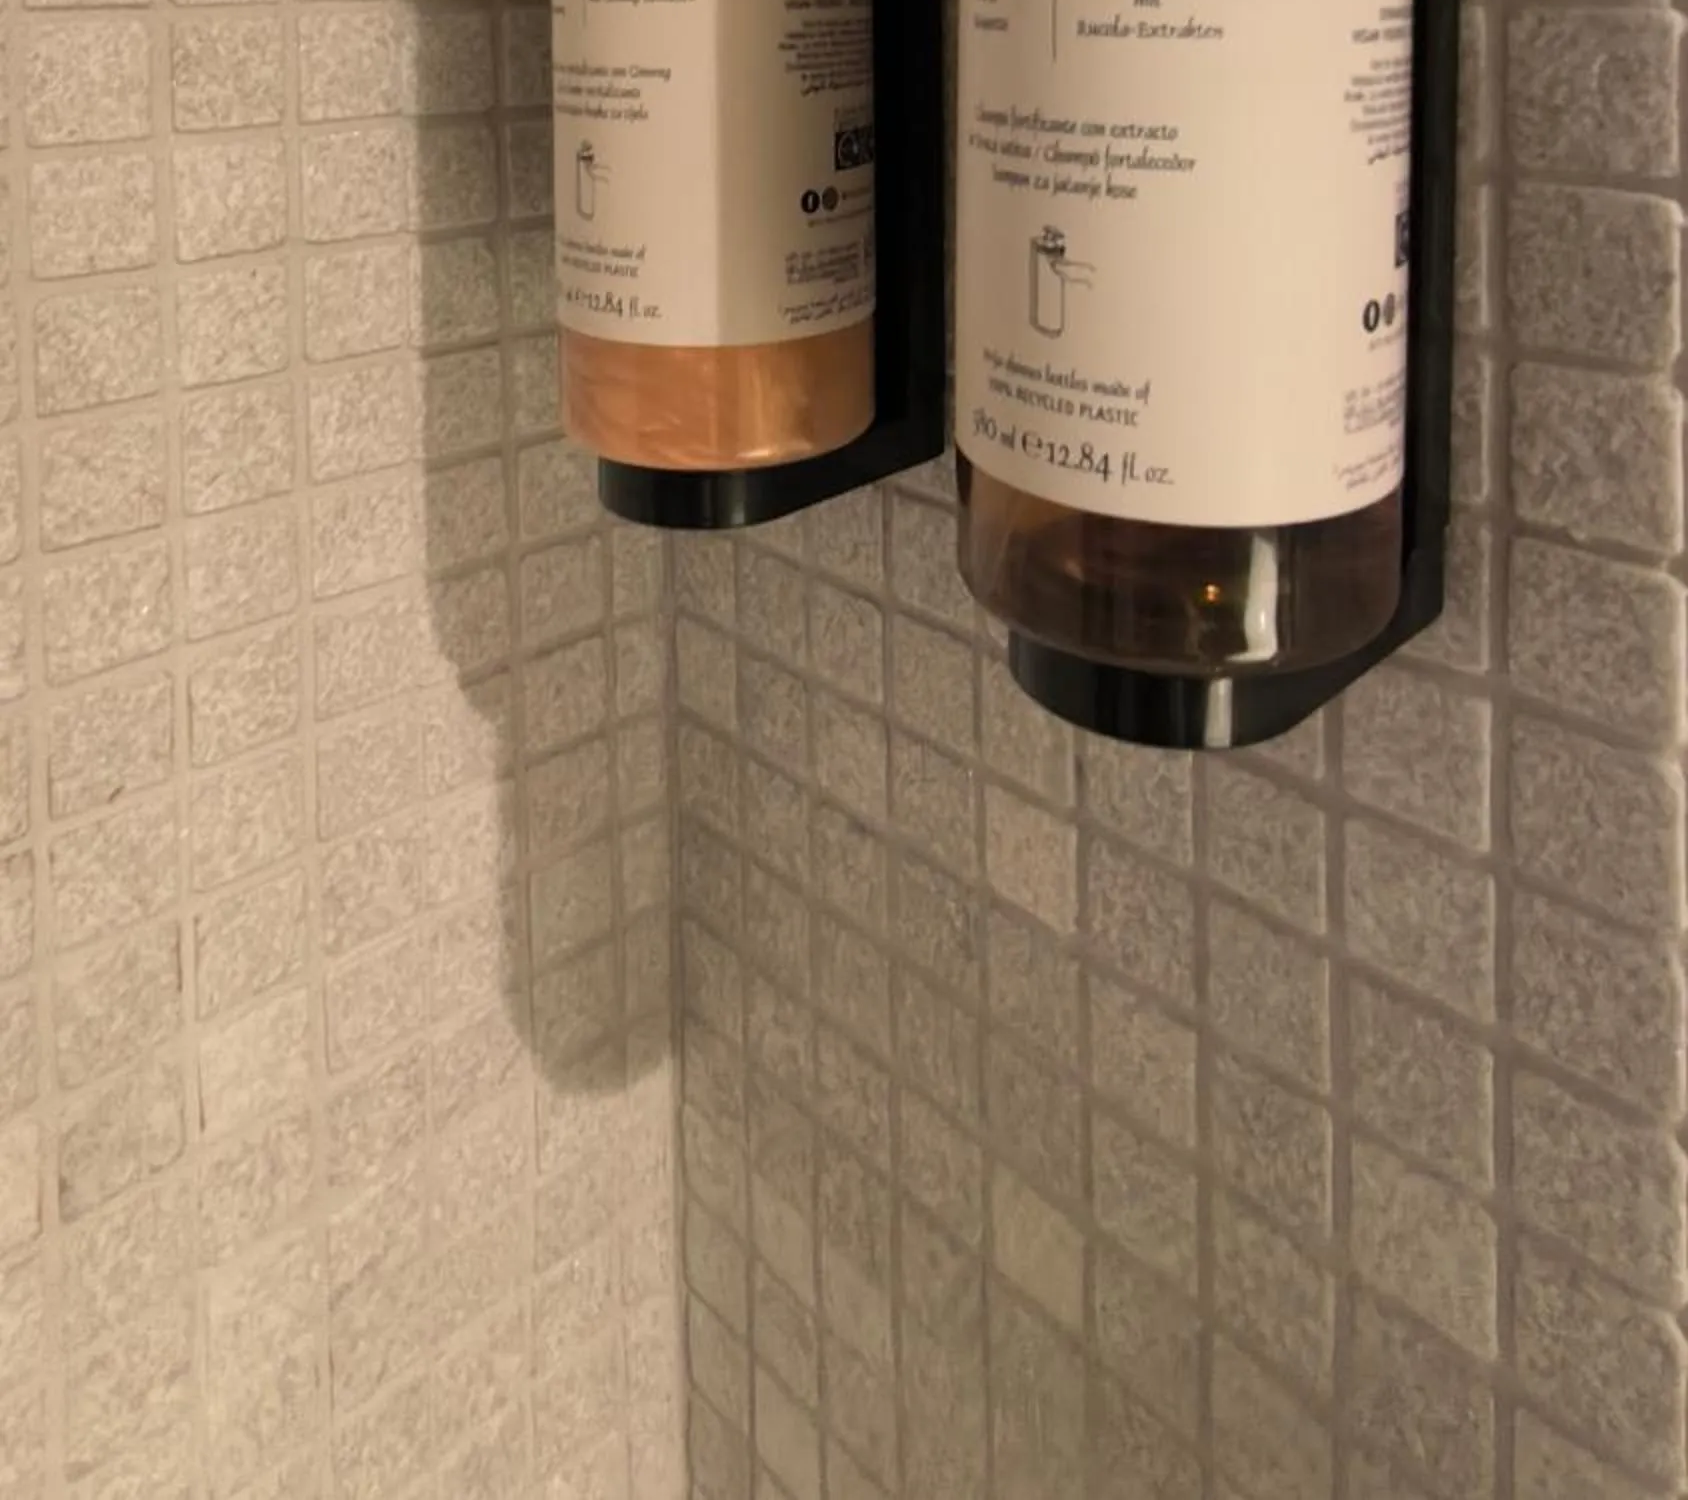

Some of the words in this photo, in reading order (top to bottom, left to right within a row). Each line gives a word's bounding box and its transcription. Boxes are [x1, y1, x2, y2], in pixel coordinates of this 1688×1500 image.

[1109, 122, 1179, 141] extracto
[1016, 386, 1075, 417] RECYCLED
[1079, 400, 1141, 428] PLASTIC
[1145, 466, 1176, 486] oz.
